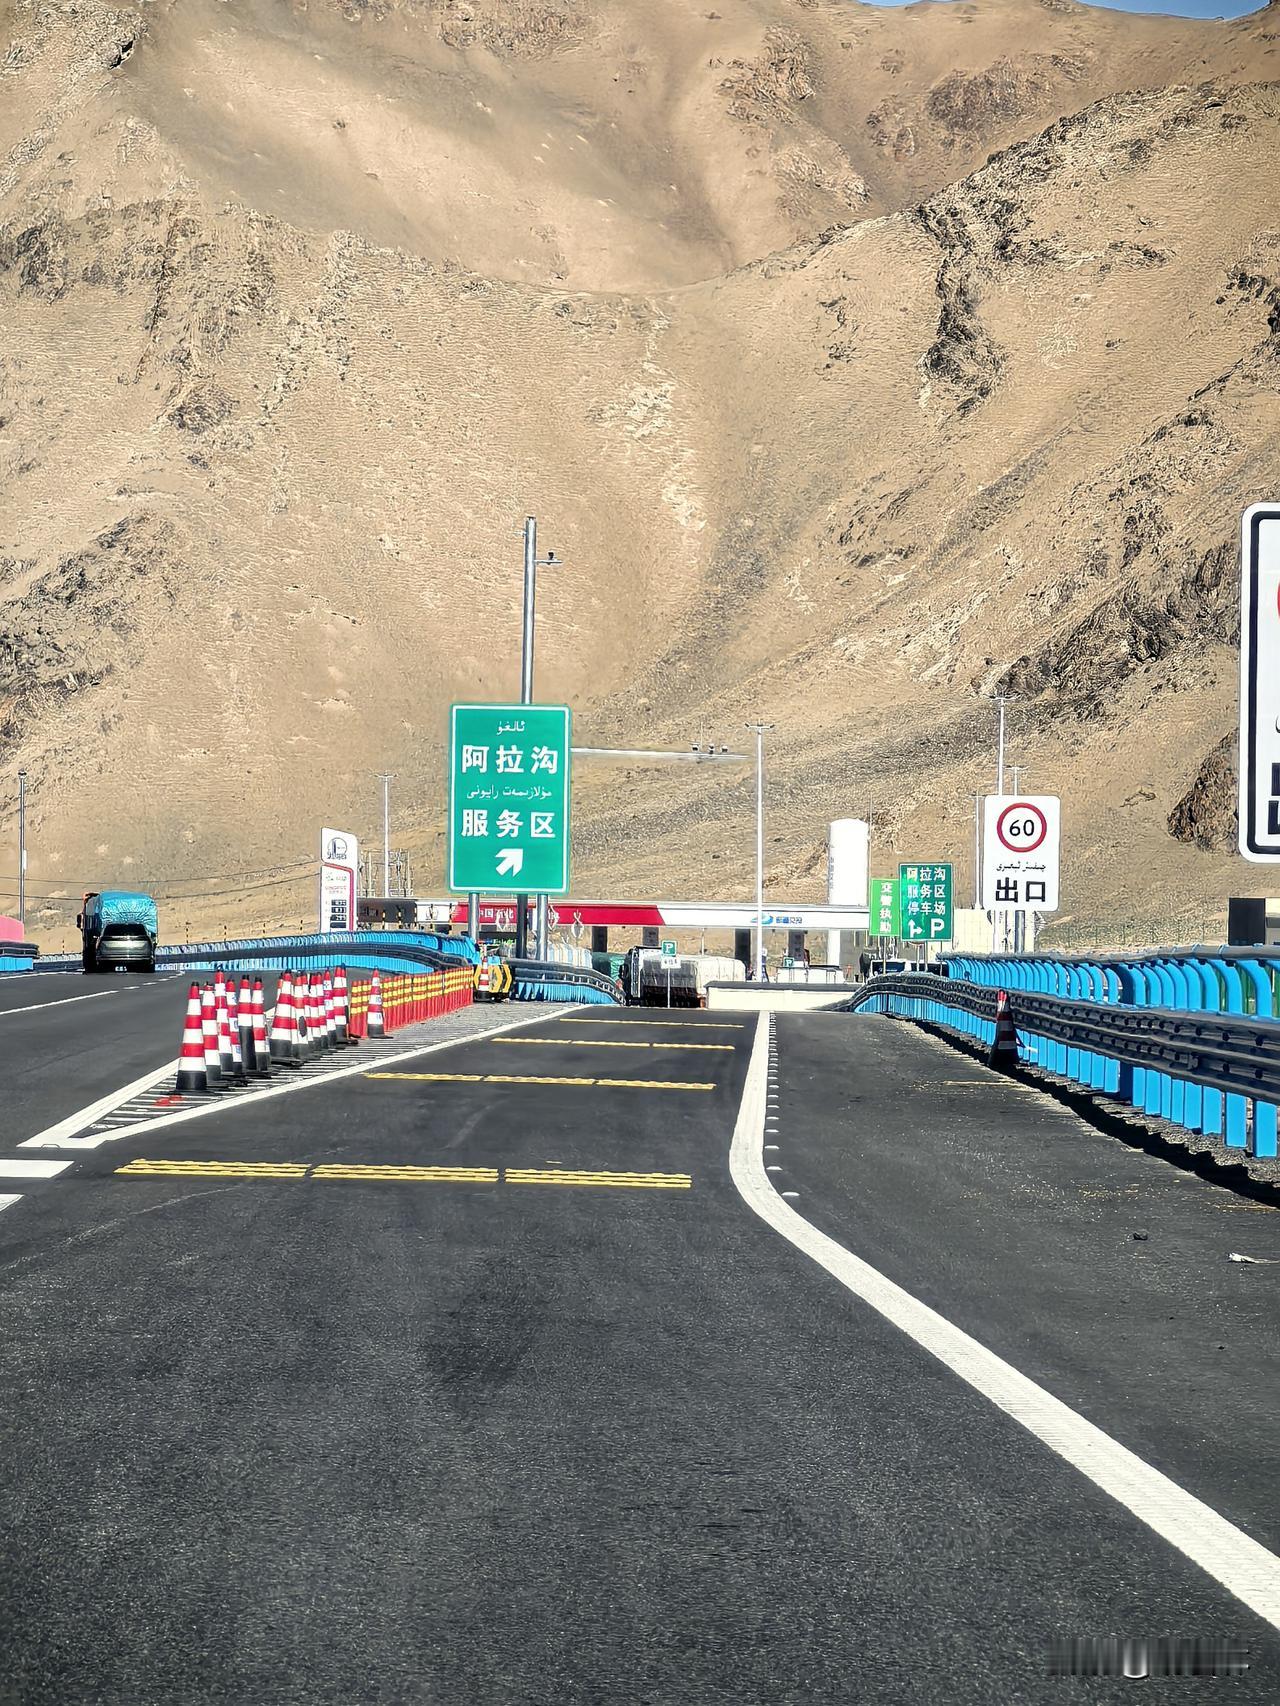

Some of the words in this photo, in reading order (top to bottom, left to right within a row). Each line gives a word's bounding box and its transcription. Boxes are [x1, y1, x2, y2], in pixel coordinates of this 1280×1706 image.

[461, 744, 559, 775] 阿拉沟
[461, 809, 556, 838] 服务区
[1009, 819, 1035, 837] 60
[906, 867, 946, 881] 阿拉沟
[907, 884, 946, 898] 服务区
[995, 877, 1046, 903] 出口
[908, 901, 946, 915] 停车场
[931, 918, 945, 938] P
[664, 943, 674, 954] P
